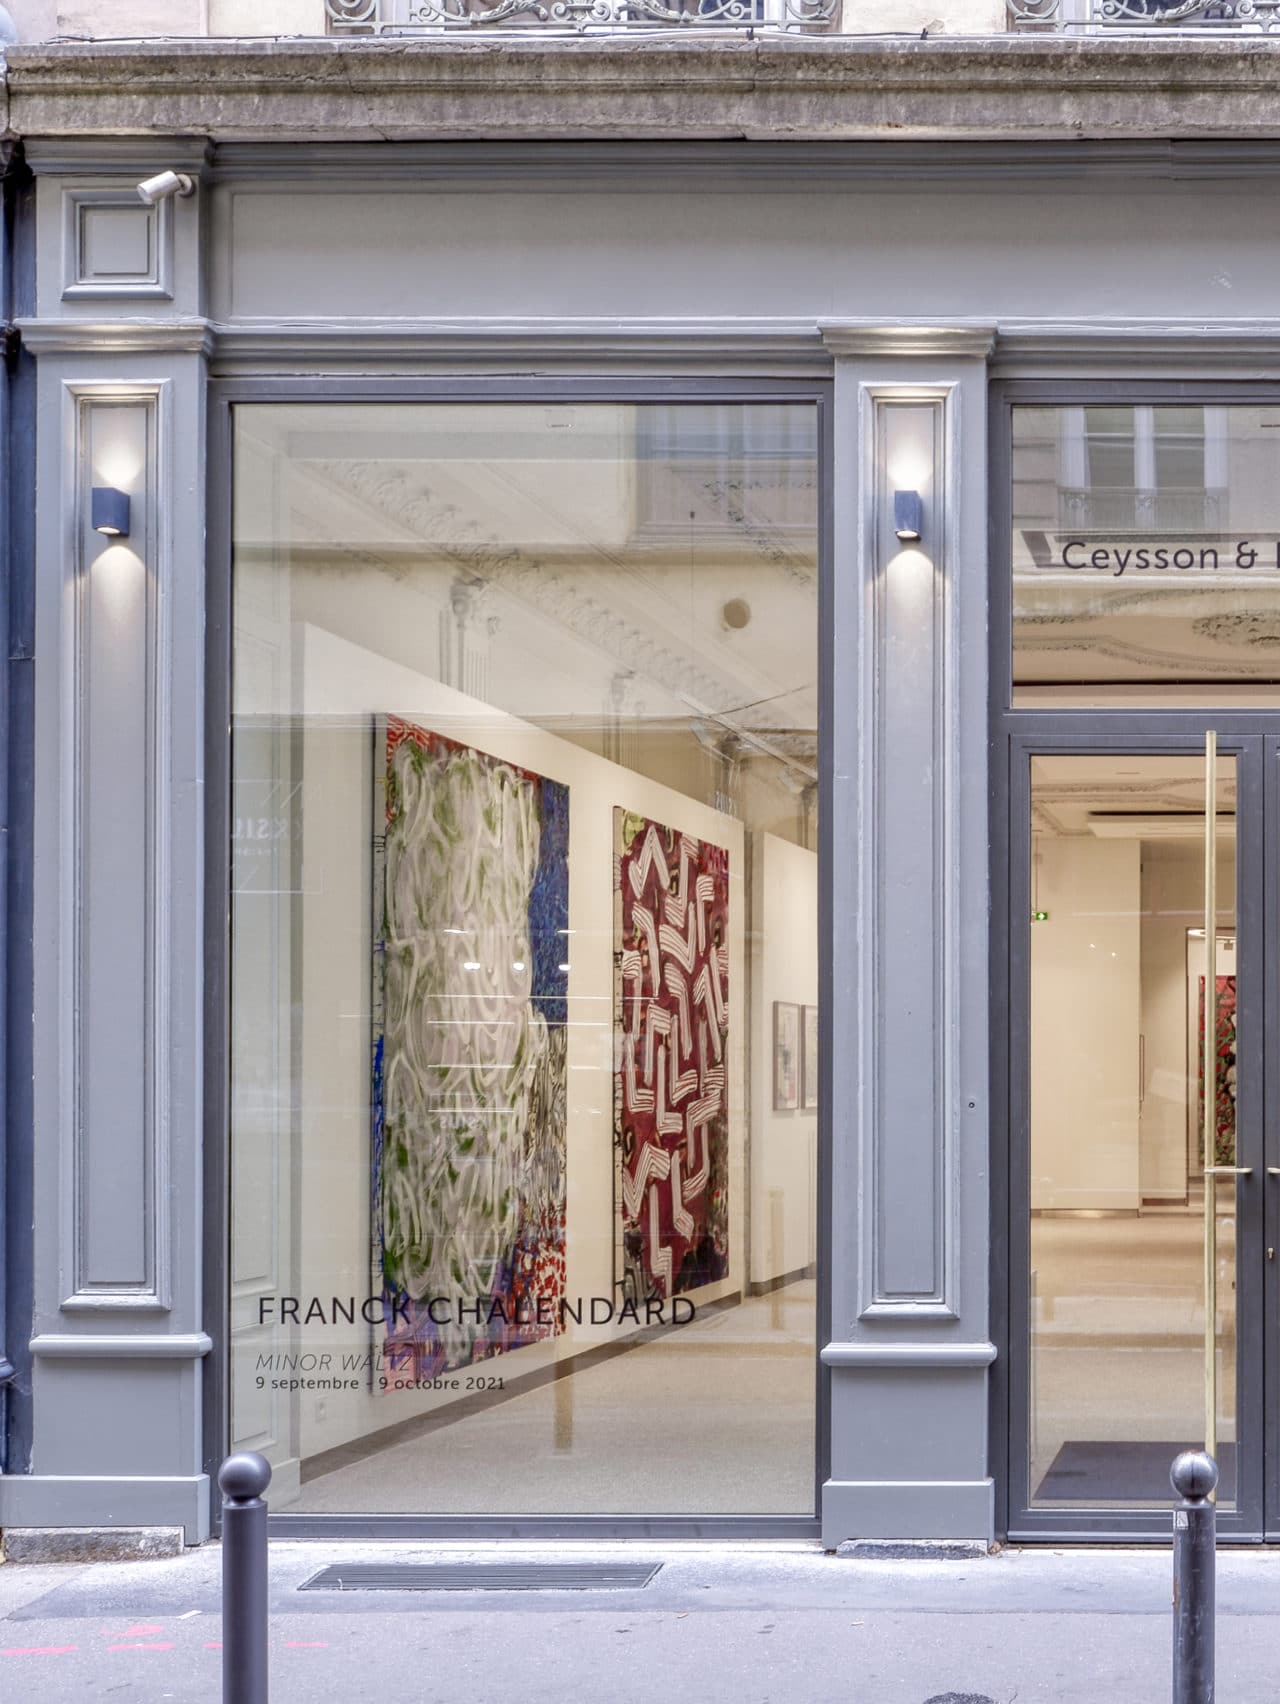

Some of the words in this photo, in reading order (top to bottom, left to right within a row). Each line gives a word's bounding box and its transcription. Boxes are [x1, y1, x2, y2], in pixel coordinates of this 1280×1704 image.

[1062, 541, 1218, 577] Ceysson
[1236, 541, 1258, 569] &
[259, 1297, 411, 1325] FRANCK
[428, 1297, 696, 1325] CHALENDARD
[256, 1353, 332, 1371] MINOR
[255, 1376, 265, 1389] 9
[271, 1376, 359, 1392] septembre
[378, 1376, 388, 1389] 9
[394, 1376, 460, 1390] octobre
[465, 1377, 505, 1390] 2021
